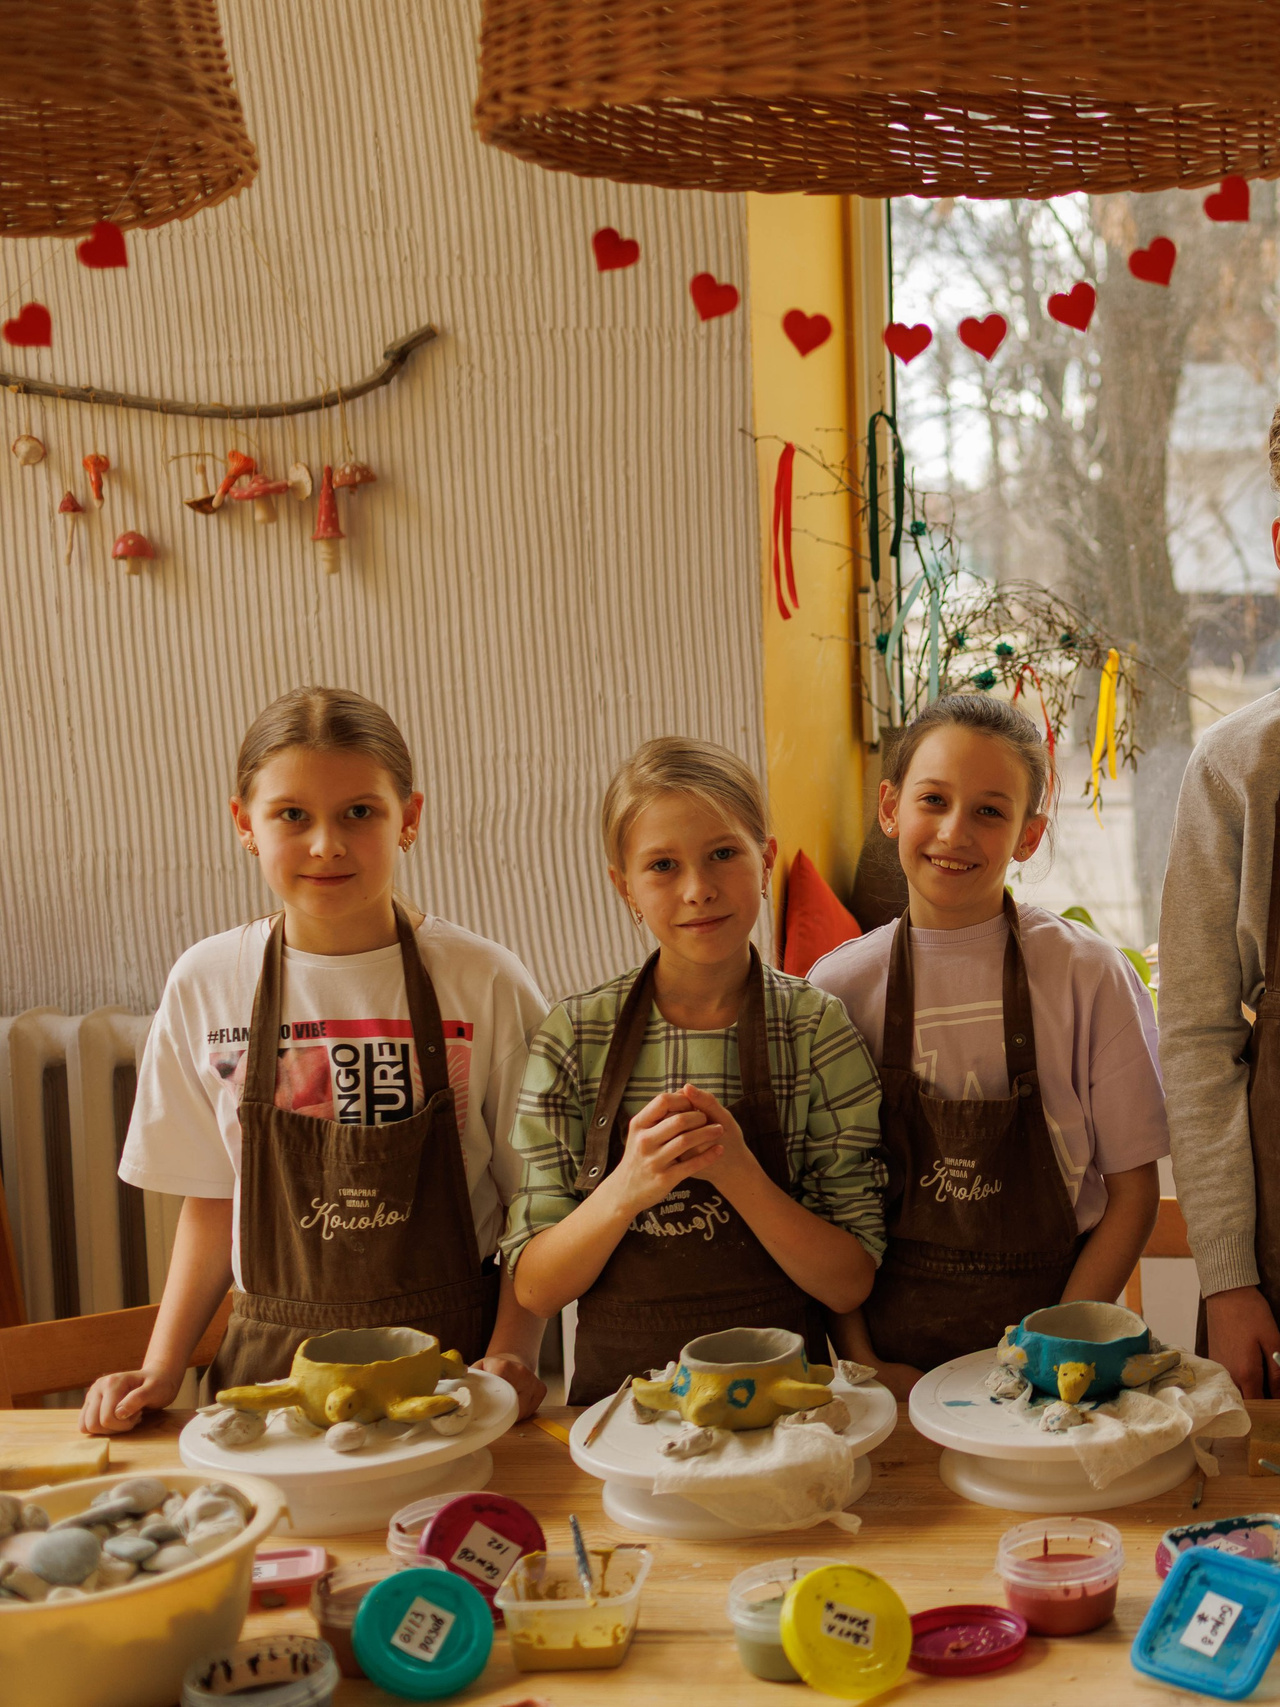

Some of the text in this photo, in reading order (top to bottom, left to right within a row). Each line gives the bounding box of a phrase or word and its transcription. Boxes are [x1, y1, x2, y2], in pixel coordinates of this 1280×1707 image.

[294, 1021, 328, 1039] VIBE
[331, 1043, 362, 1125] INGO
[338, 1188, 377, 1197] ГОНЧАРНАЯ
[345, 1199, 370, 1208] ШКОЛА
